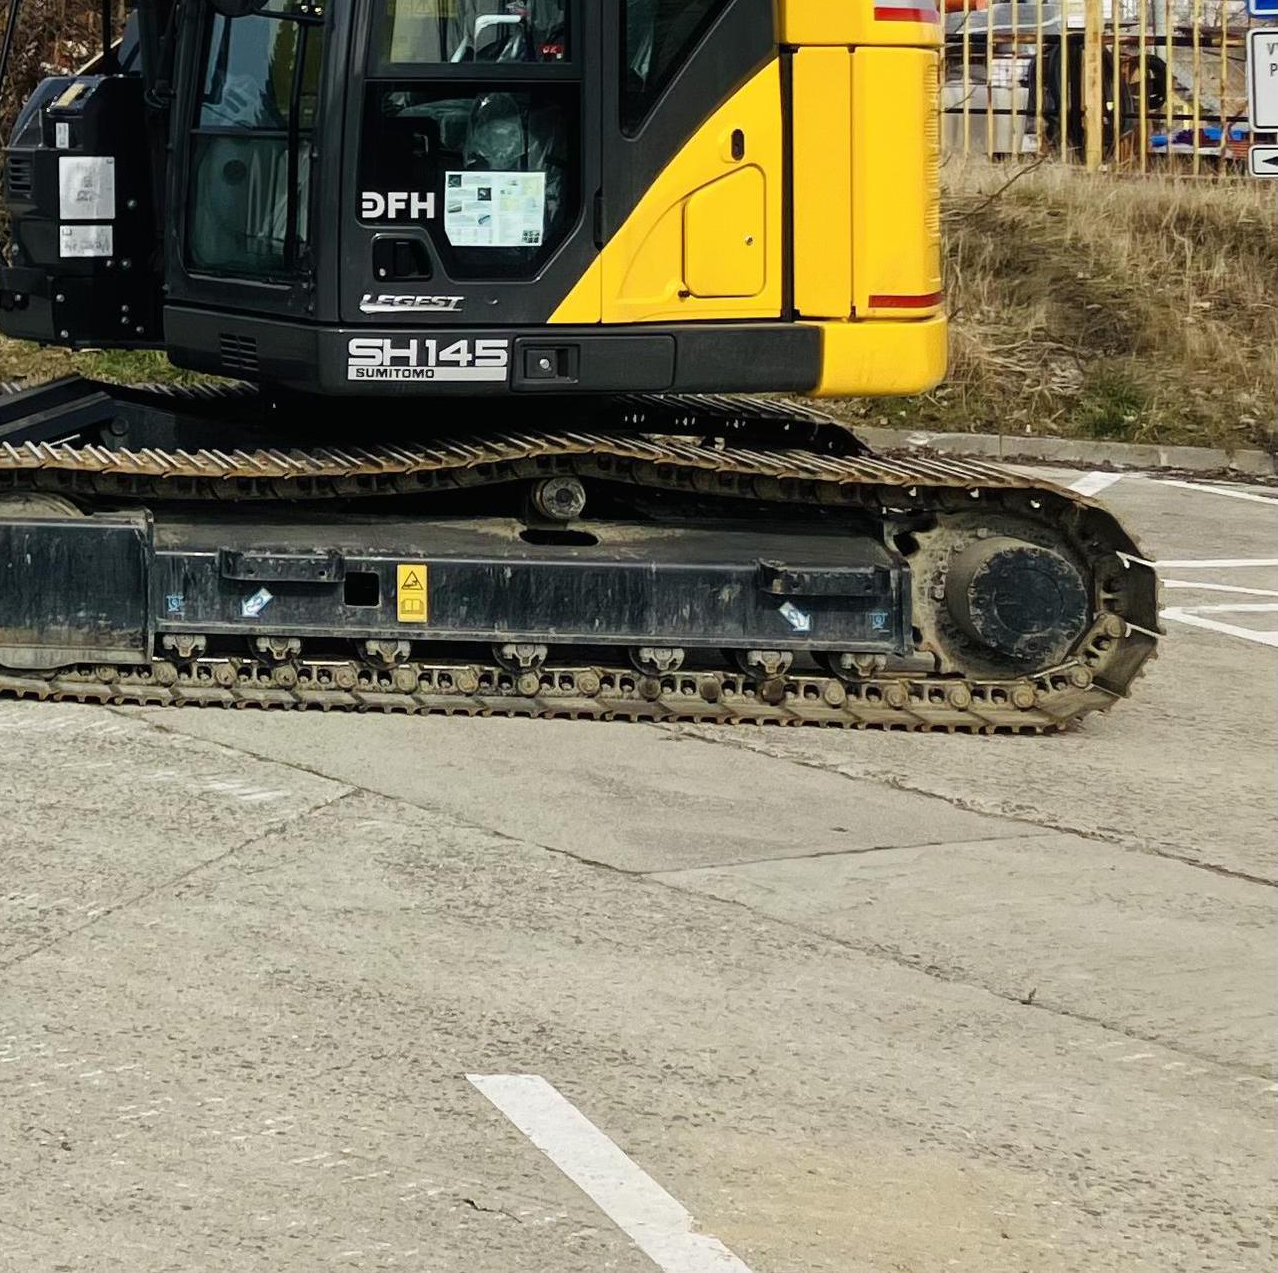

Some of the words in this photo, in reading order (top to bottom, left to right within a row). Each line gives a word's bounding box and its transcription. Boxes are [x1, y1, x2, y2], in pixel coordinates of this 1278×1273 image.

[362, 191, 435, 219] DFH
[359, 294, 465, 314] LEGEST
[355, 368, 435, 379] SUMITOMO
